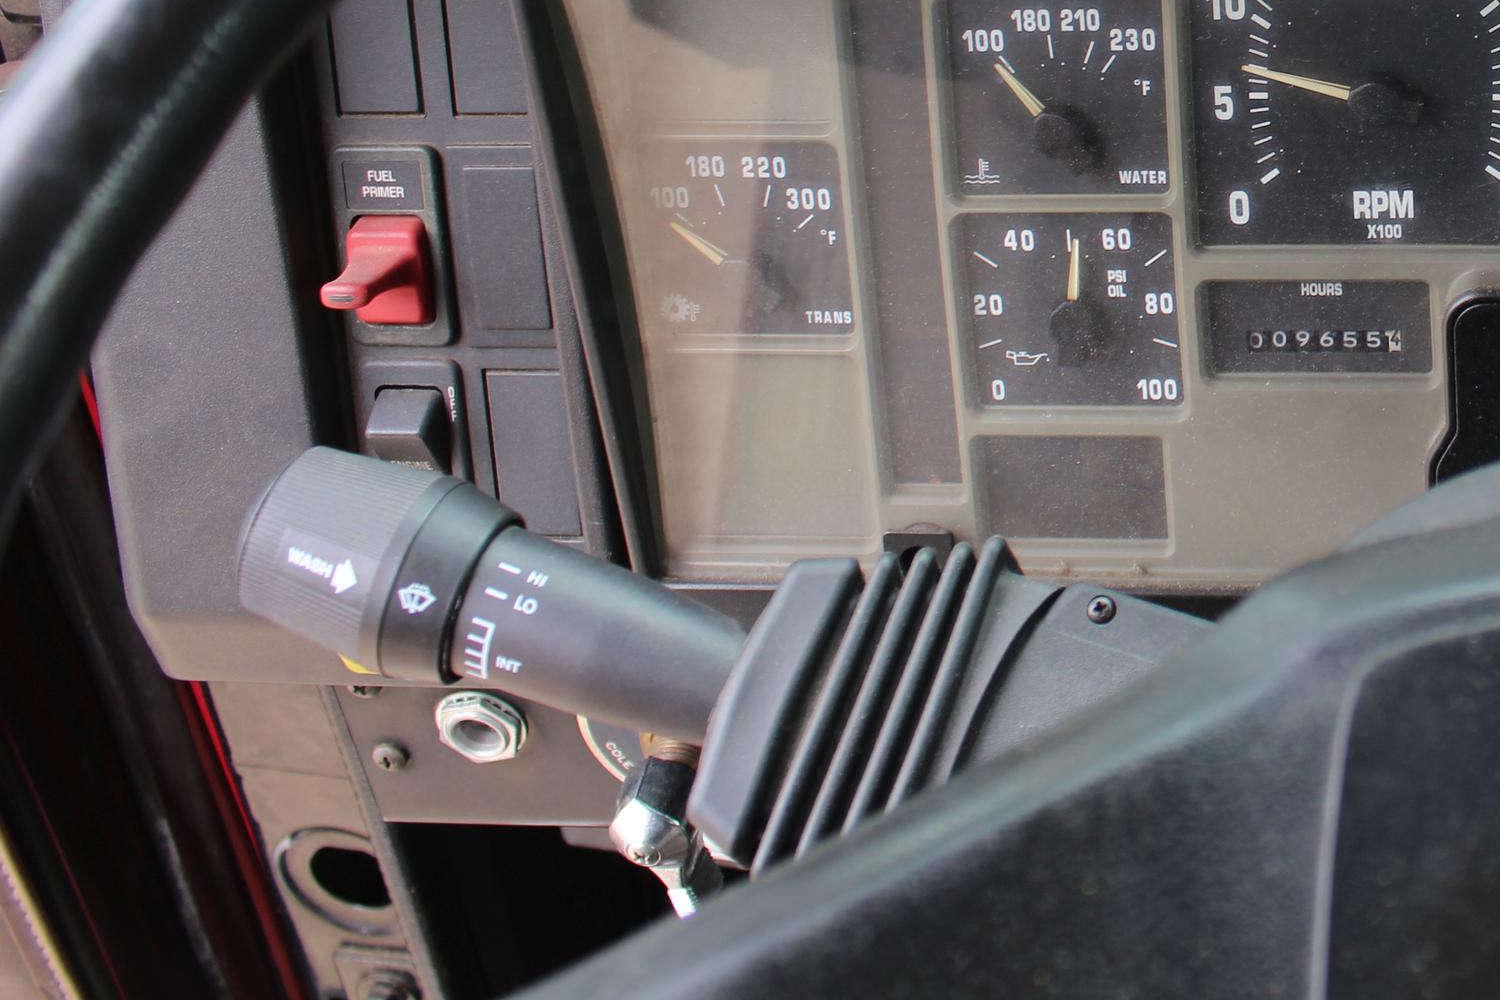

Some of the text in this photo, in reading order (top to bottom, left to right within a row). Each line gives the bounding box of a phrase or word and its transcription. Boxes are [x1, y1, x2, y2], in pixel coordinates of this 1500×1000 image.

[1010, 9, 1050, 32] 180
[1060, 8, 1100, 32] 210
[962, 29, 1004, 52] 100
[1110, 28, 1156, 52] 230
[1213, 85, 1235, 121] 5
[367, 170, 397, 182] FUEL
[685, 155, 725, 178] 180
[741, 156, 787, 179] 220
[1119, 170, 1167, 184] WATER
[362, 186, 405, 199] PRIMER
[650, 187, 689, 209] 100
[785, 187, 832, 210] 300
[1229, 190, 1250, 225] 0
[1352, 190, 1415, 219] RPM
[1004, 229, 1035, 251] 40
[1102, 228, 1132, 250] 60
[1366, 223, 1402, 239] X100
[1107, 269, 1127, 283] PSI
[1107, 285, 1127, 298] OIL
[1300, 282, 1343, 296] HOURS
[973, 294, 1003, 316] 20
[1145, 293, 1174, 314] 80
[805, 310, 852, 325] TRANS
[992, 379, 1006, 400] 0
[1136, 378, 1178, 400] 100
[447, 386, 457, 422] OFF
[287, 547, 334, 579] WASH
[526, 570, 549, 588] HI
[513, 594, 539, 615] LO
[495, 655, 523, 674] INT
[605, 741, 635, 770] COLE
